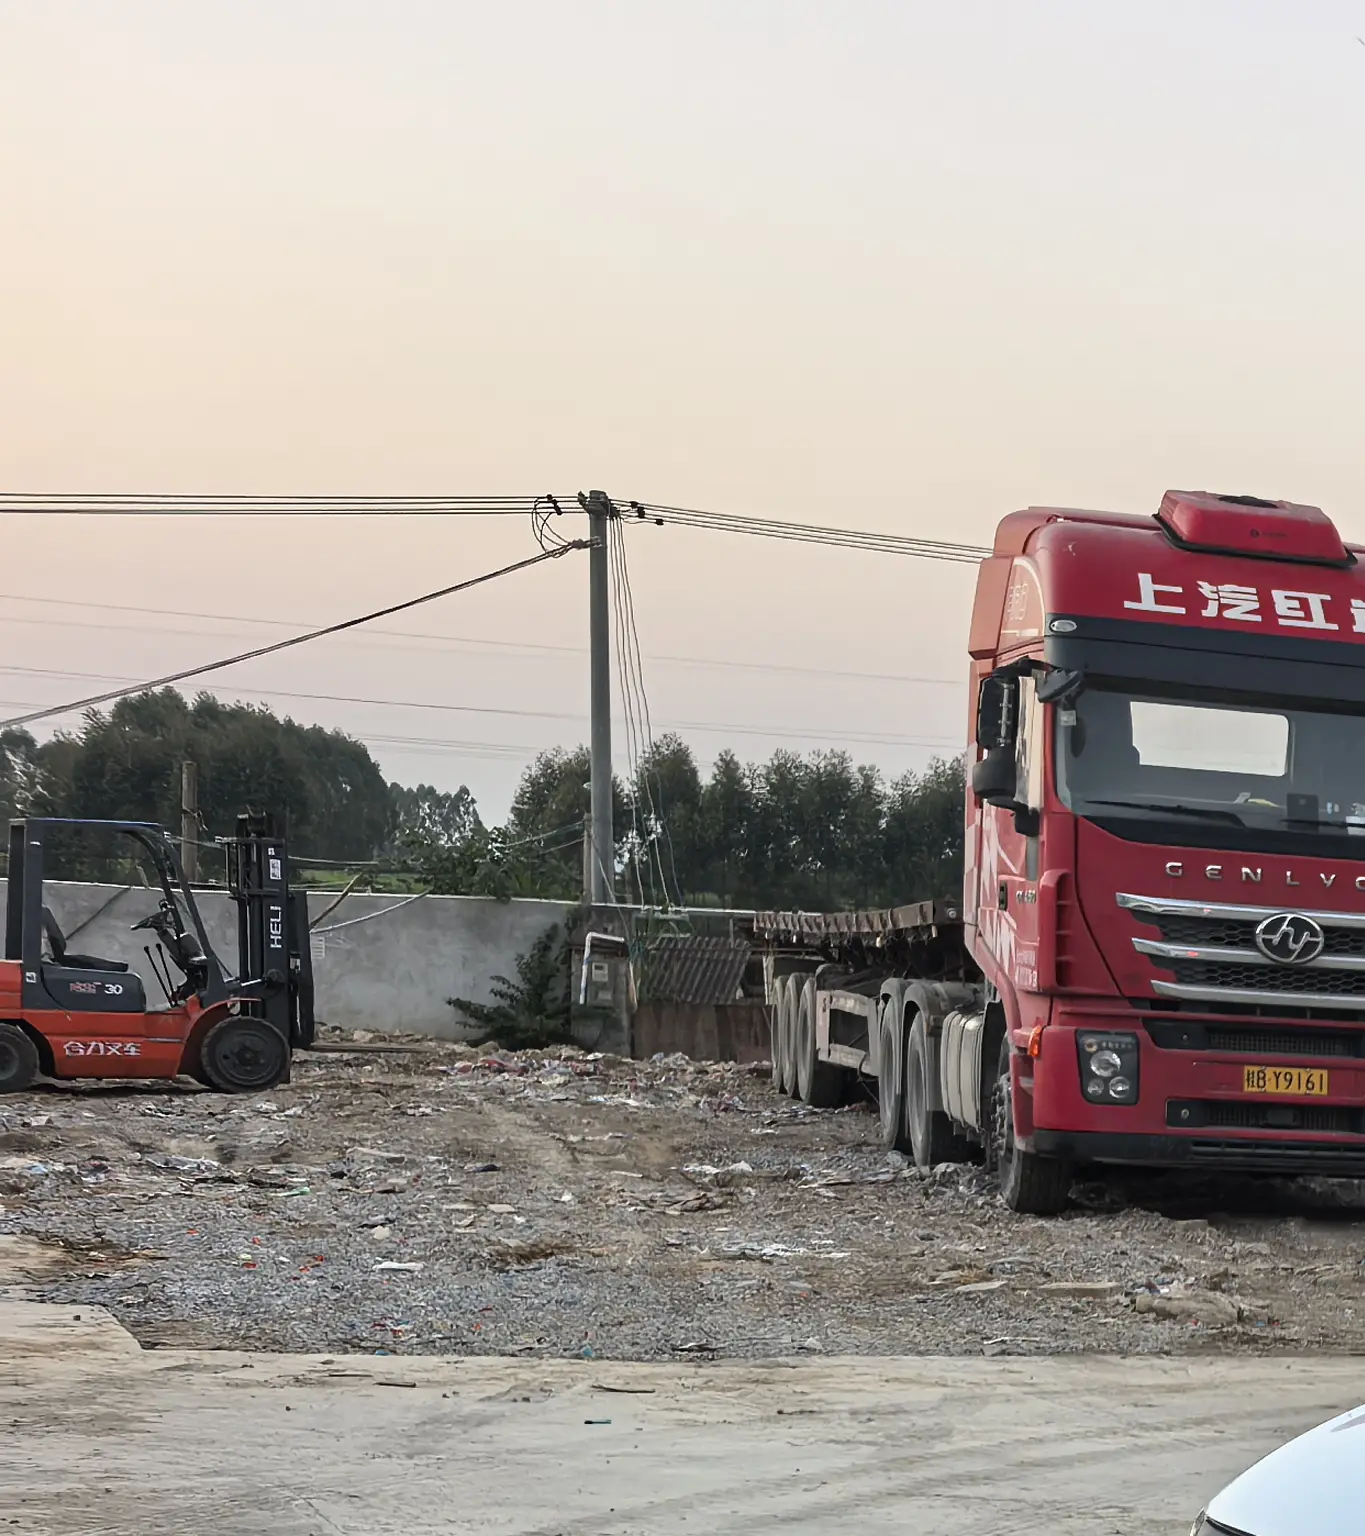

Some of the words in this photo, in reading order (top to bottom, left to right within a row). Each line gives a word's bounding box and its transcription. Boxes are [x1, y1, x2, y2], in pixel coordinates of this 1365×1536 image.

[269, 905, 283, 949] HELI
[104, 983, 124, 995] 30
[62, 1040, 142, 1057] 合力叉车
